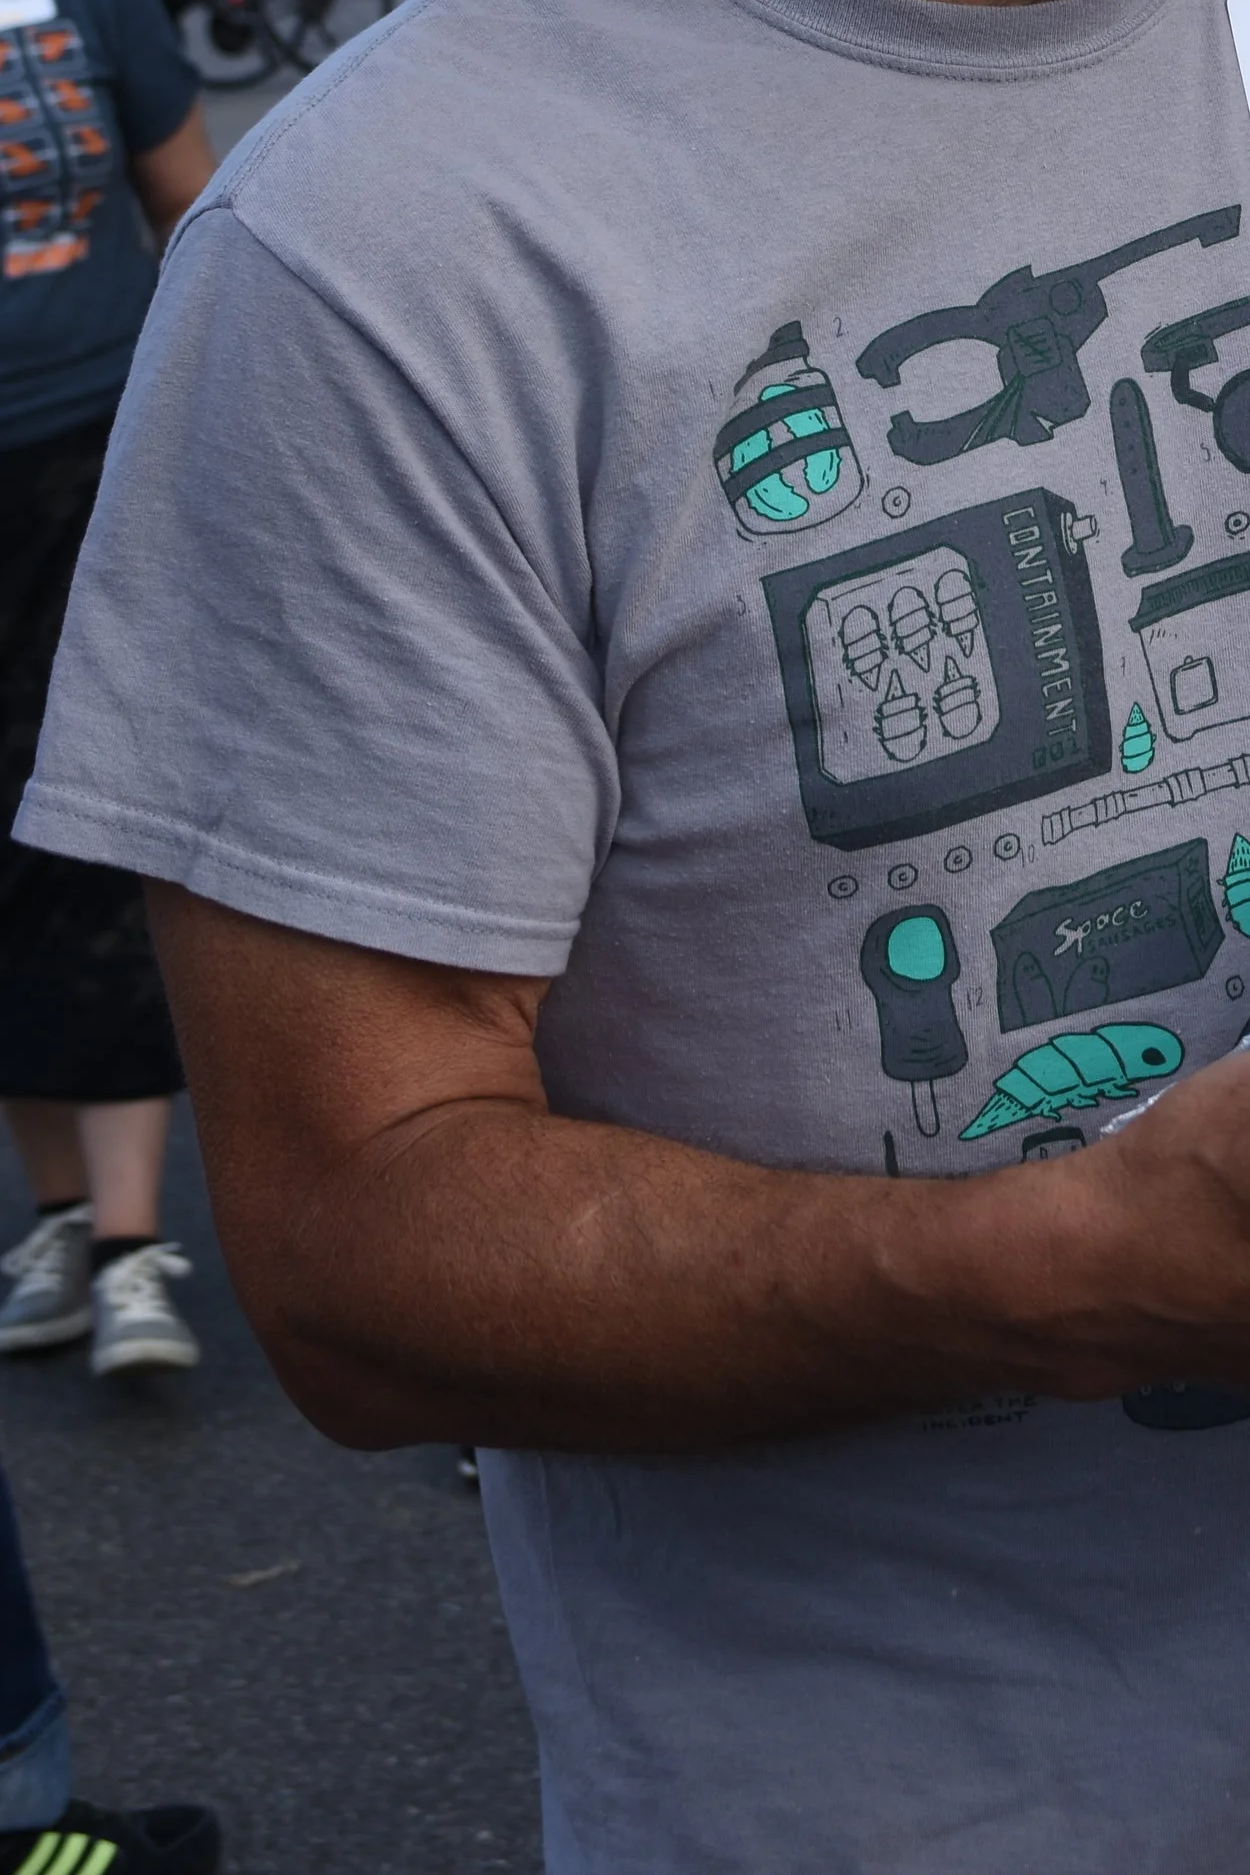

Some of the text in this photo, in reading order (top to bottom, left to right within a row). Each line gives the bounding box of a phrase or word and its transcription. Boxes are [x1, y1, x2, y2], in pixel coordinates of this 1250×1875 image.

[1002, 505, 1078, 736] CONTAINMENT
[1053, 899, 1150, 957] Space
[921, 1410, 1030, 1433] INCIDENT
[994, 1393, 1039, 1410] THE
